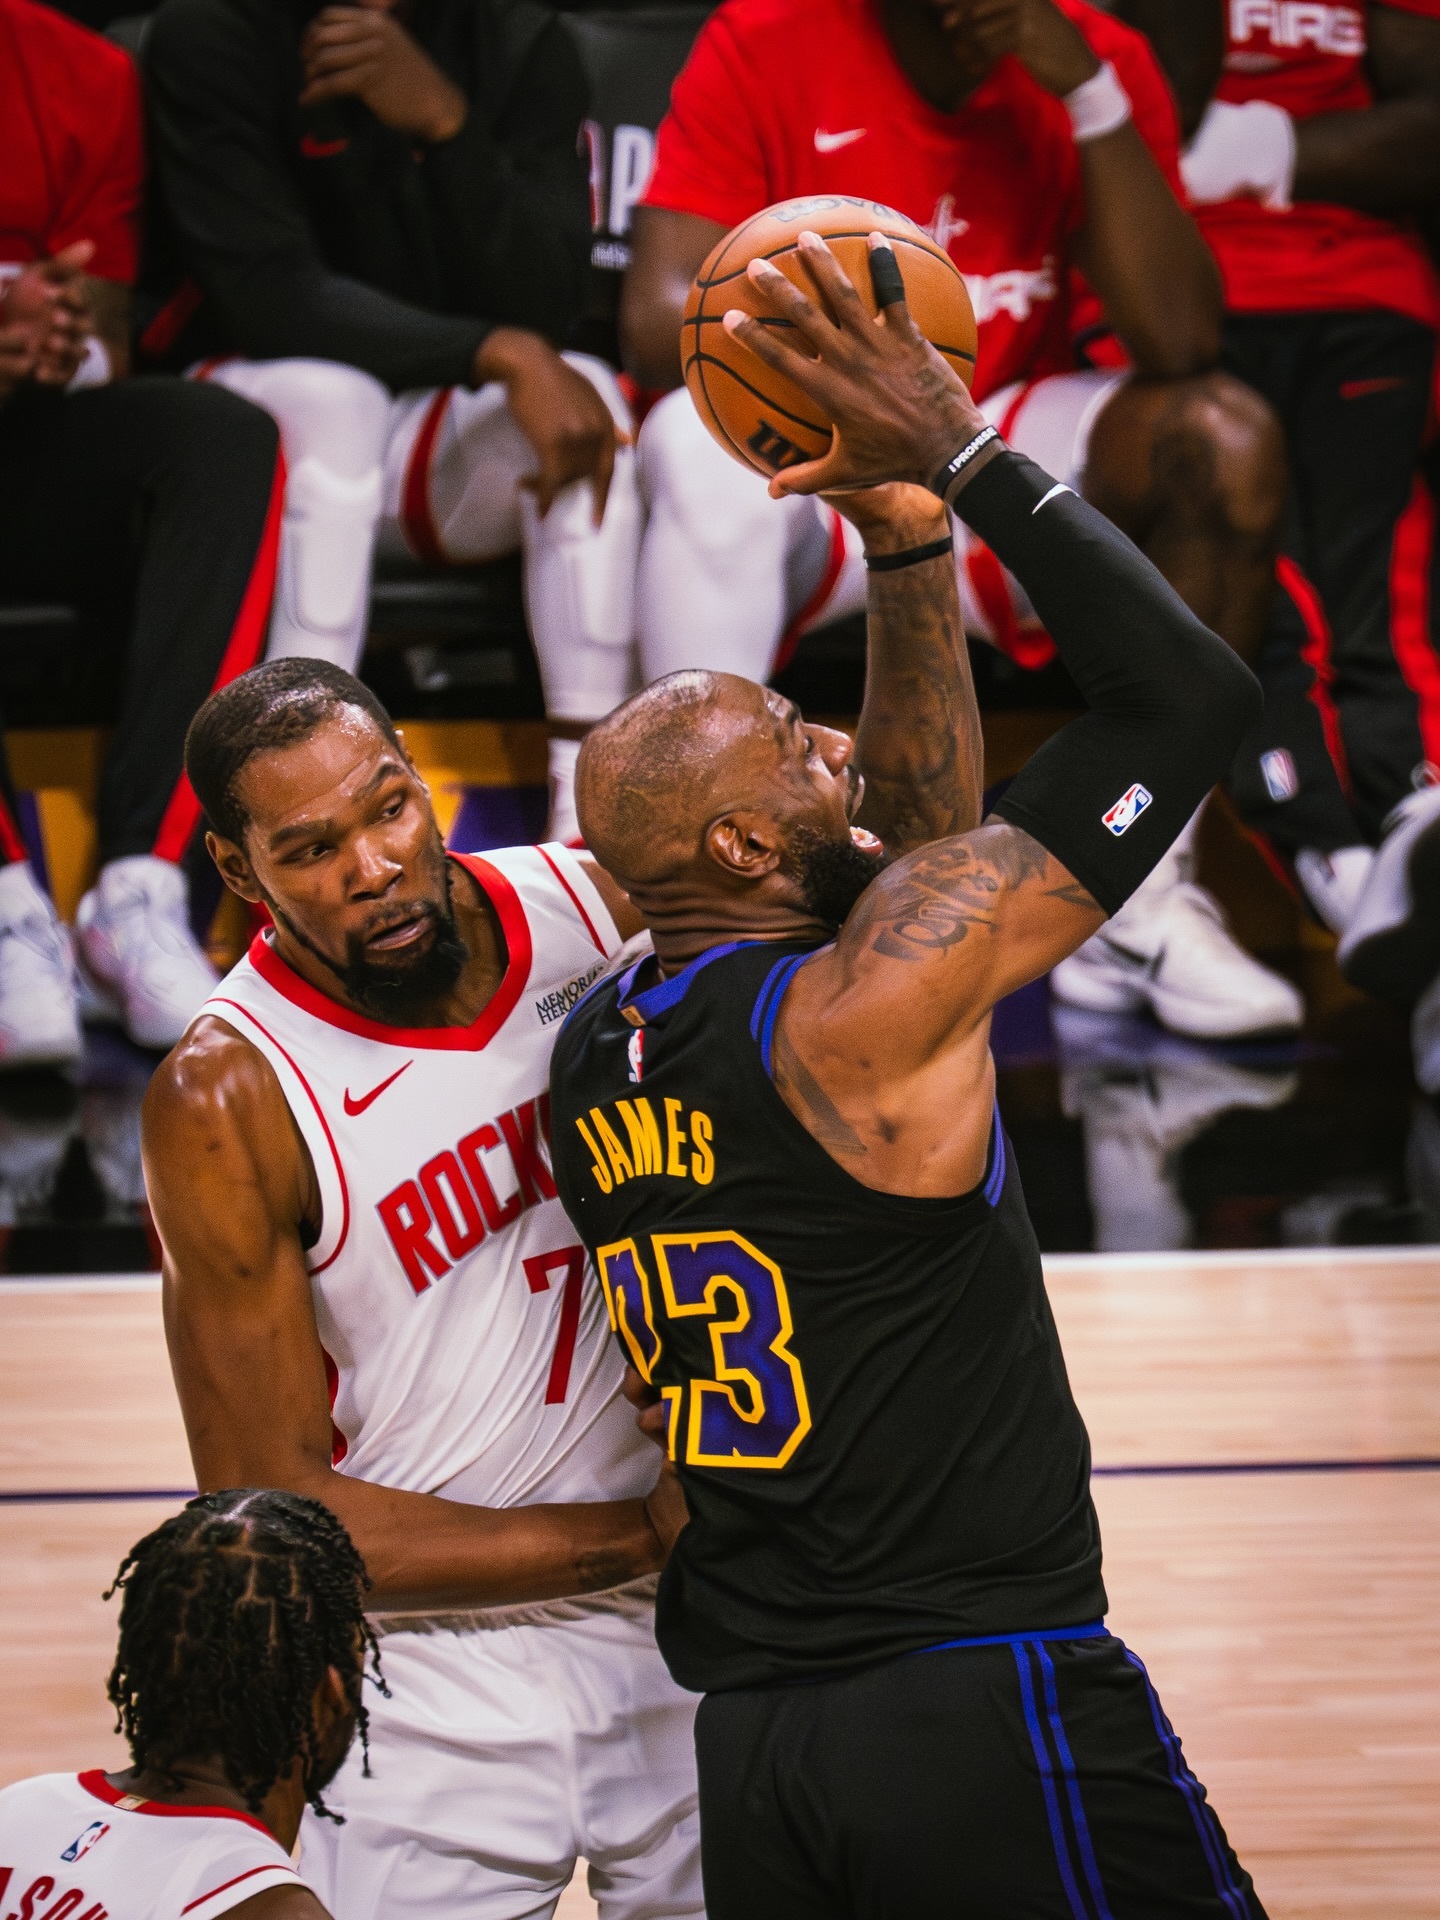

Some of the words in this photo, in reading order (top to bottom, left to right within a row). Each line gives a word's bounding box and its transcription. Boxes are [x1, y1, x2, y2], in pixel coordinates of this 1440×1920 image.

[948, 464, 957, 473] I
[952, 426, 998, 469] PROMISE
[575, 1097, 715, 1195] JAMES
[522, 1245, 585, 1405] 7
